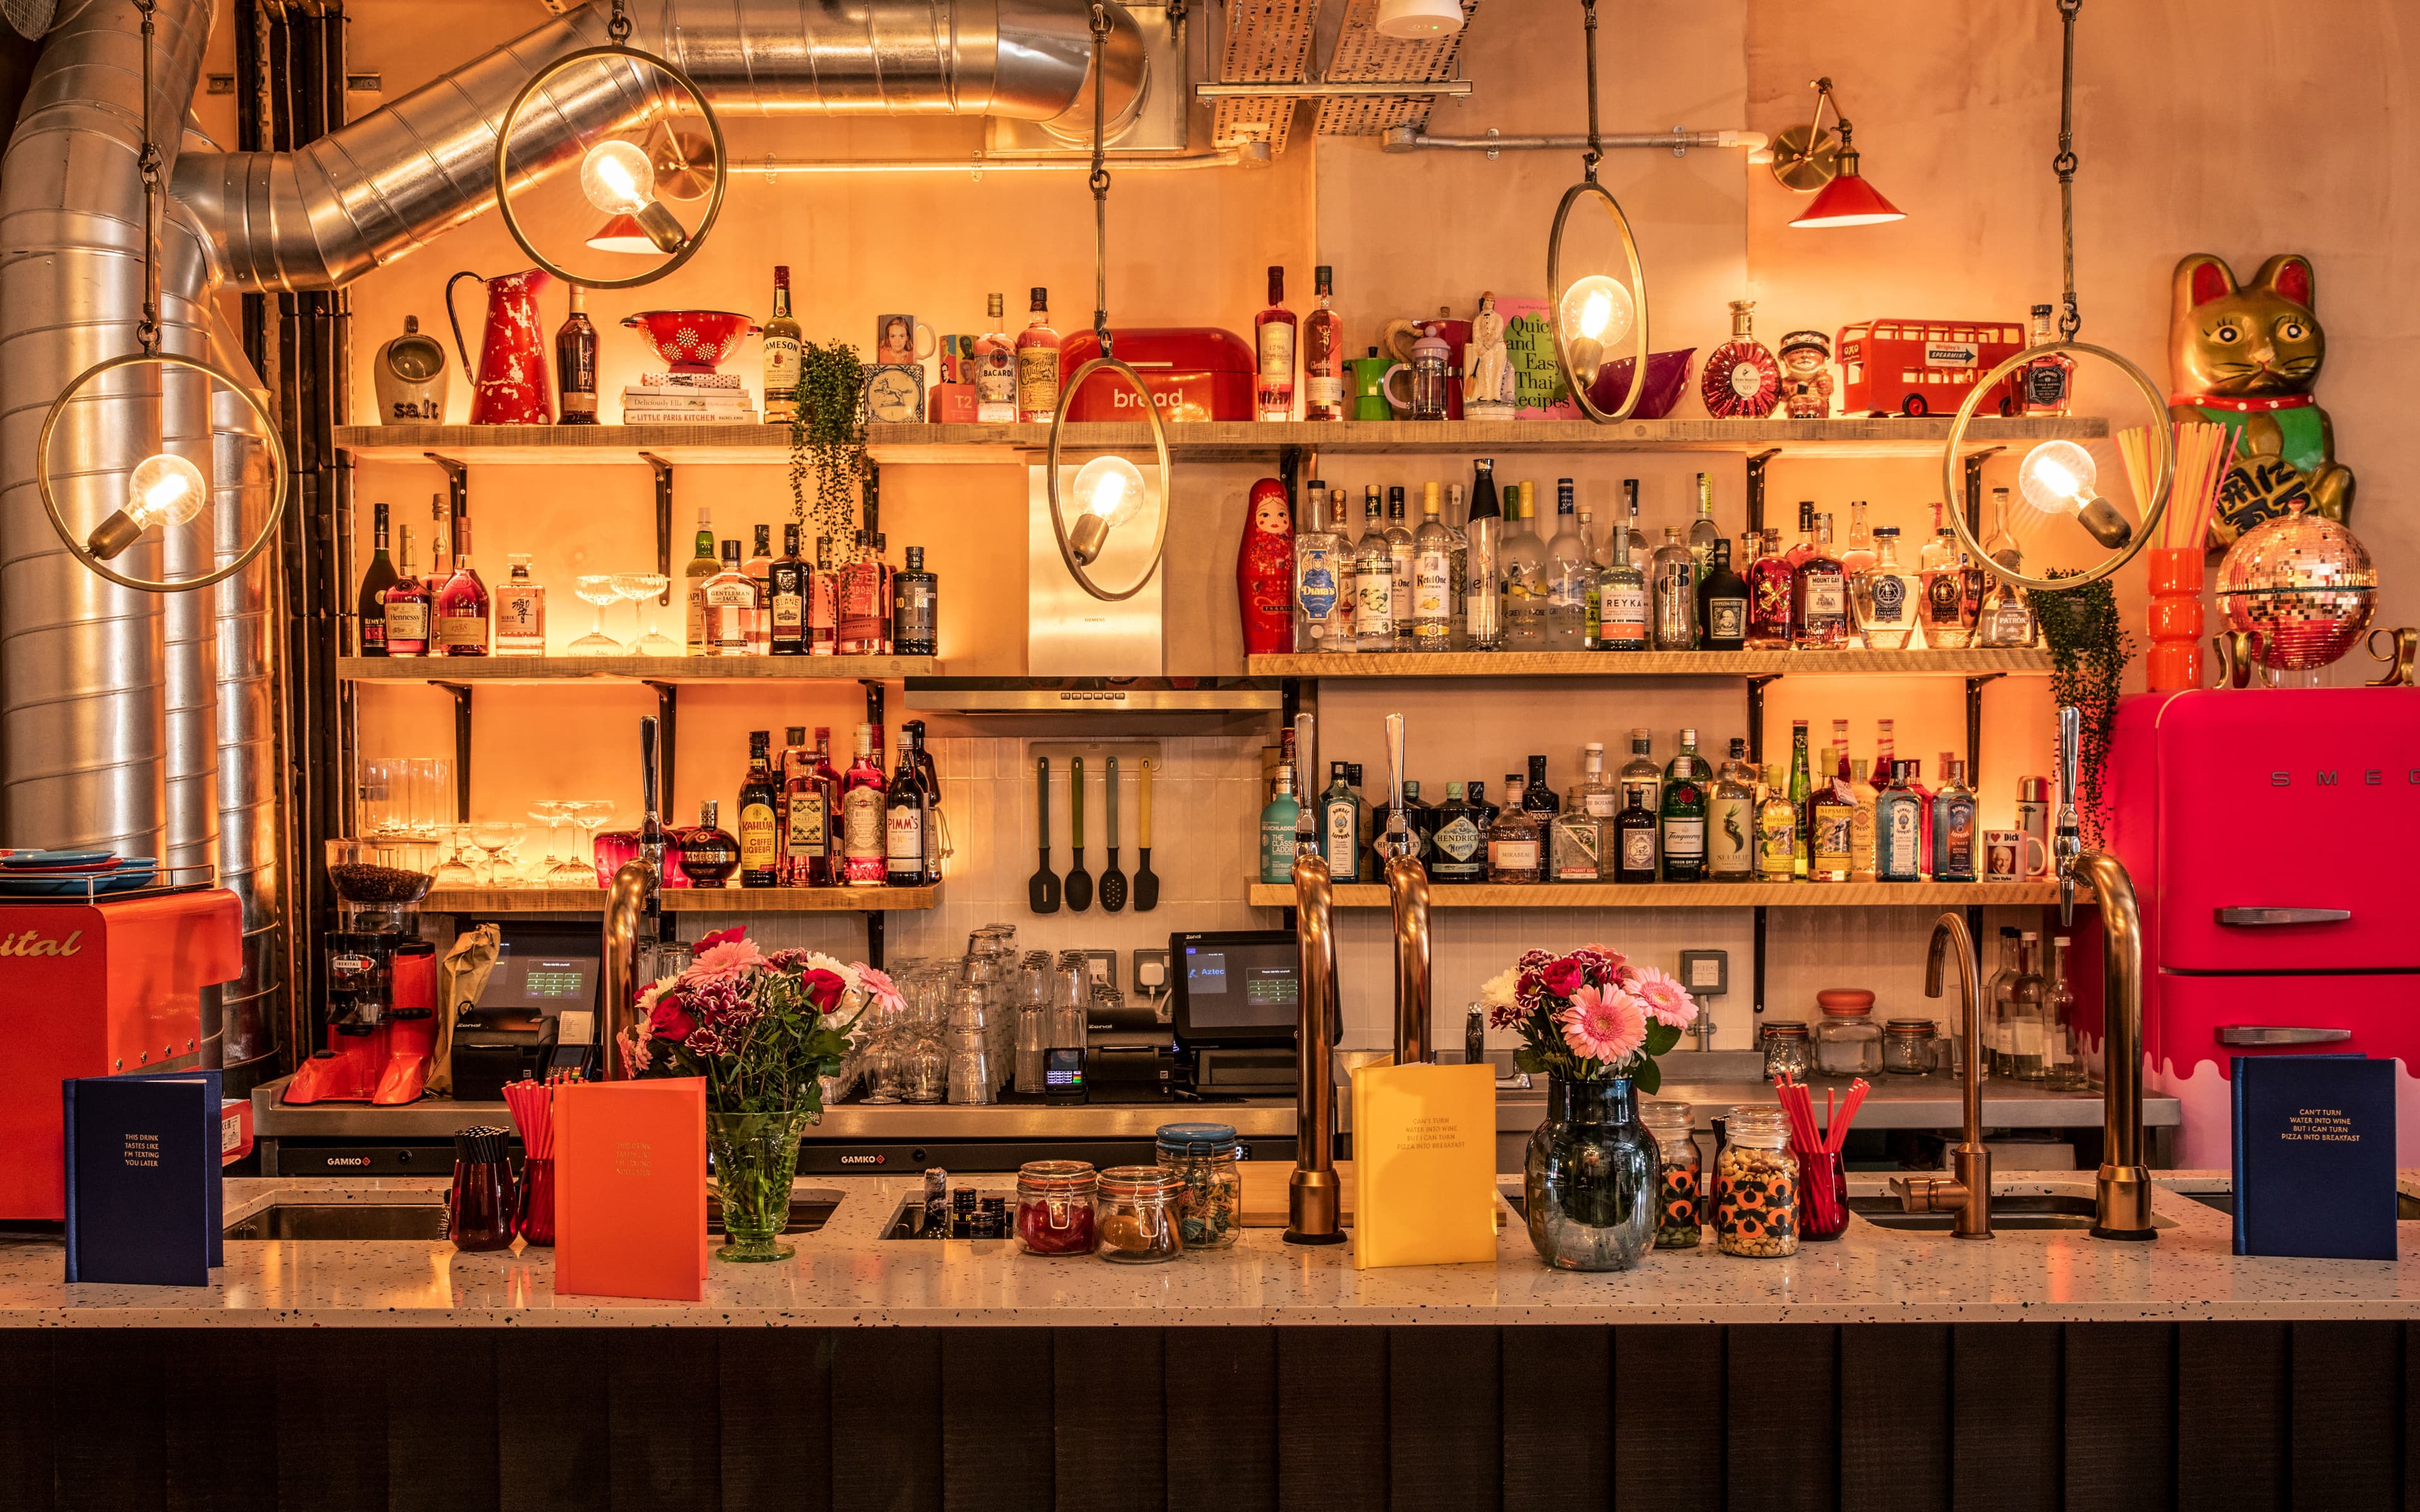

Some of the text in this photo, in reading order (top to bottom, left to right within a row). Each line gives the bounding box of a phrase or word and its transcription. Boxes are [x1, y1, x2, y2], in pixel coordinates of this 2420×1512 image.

[1511, 316, 1551, 336] Quic
[763, 340, 798, 353] JAMESON
[1506, 335, 1536, 351] and
[1844, 344, 1859, 355] OXO
[1525, 353, 1560, 375] Easy
[579, 370, 592, 386] IPA
[984, 369, 1013, 377] BACARDÍ
[1515, 372, 1553, 389] Thai
[635, 399, 669, 408] Deliciously
[955, 395, 972, 408] T2
[1514, 393, 1570, 413] ecipes
[393, 400, 439, 420] salt
[1417, 575, 1446, 587] Ketel One
[776, 598, 799, 606] SLANE
[896, 597, 905, 608] 10
[1607, 599, 1642, 607] REYKA
[1999, 616, 2026, 624] PATRÓN
[888, 816, 918, 830] PIMM'S
[1669, 831, 1701, 841] Tanqueray
